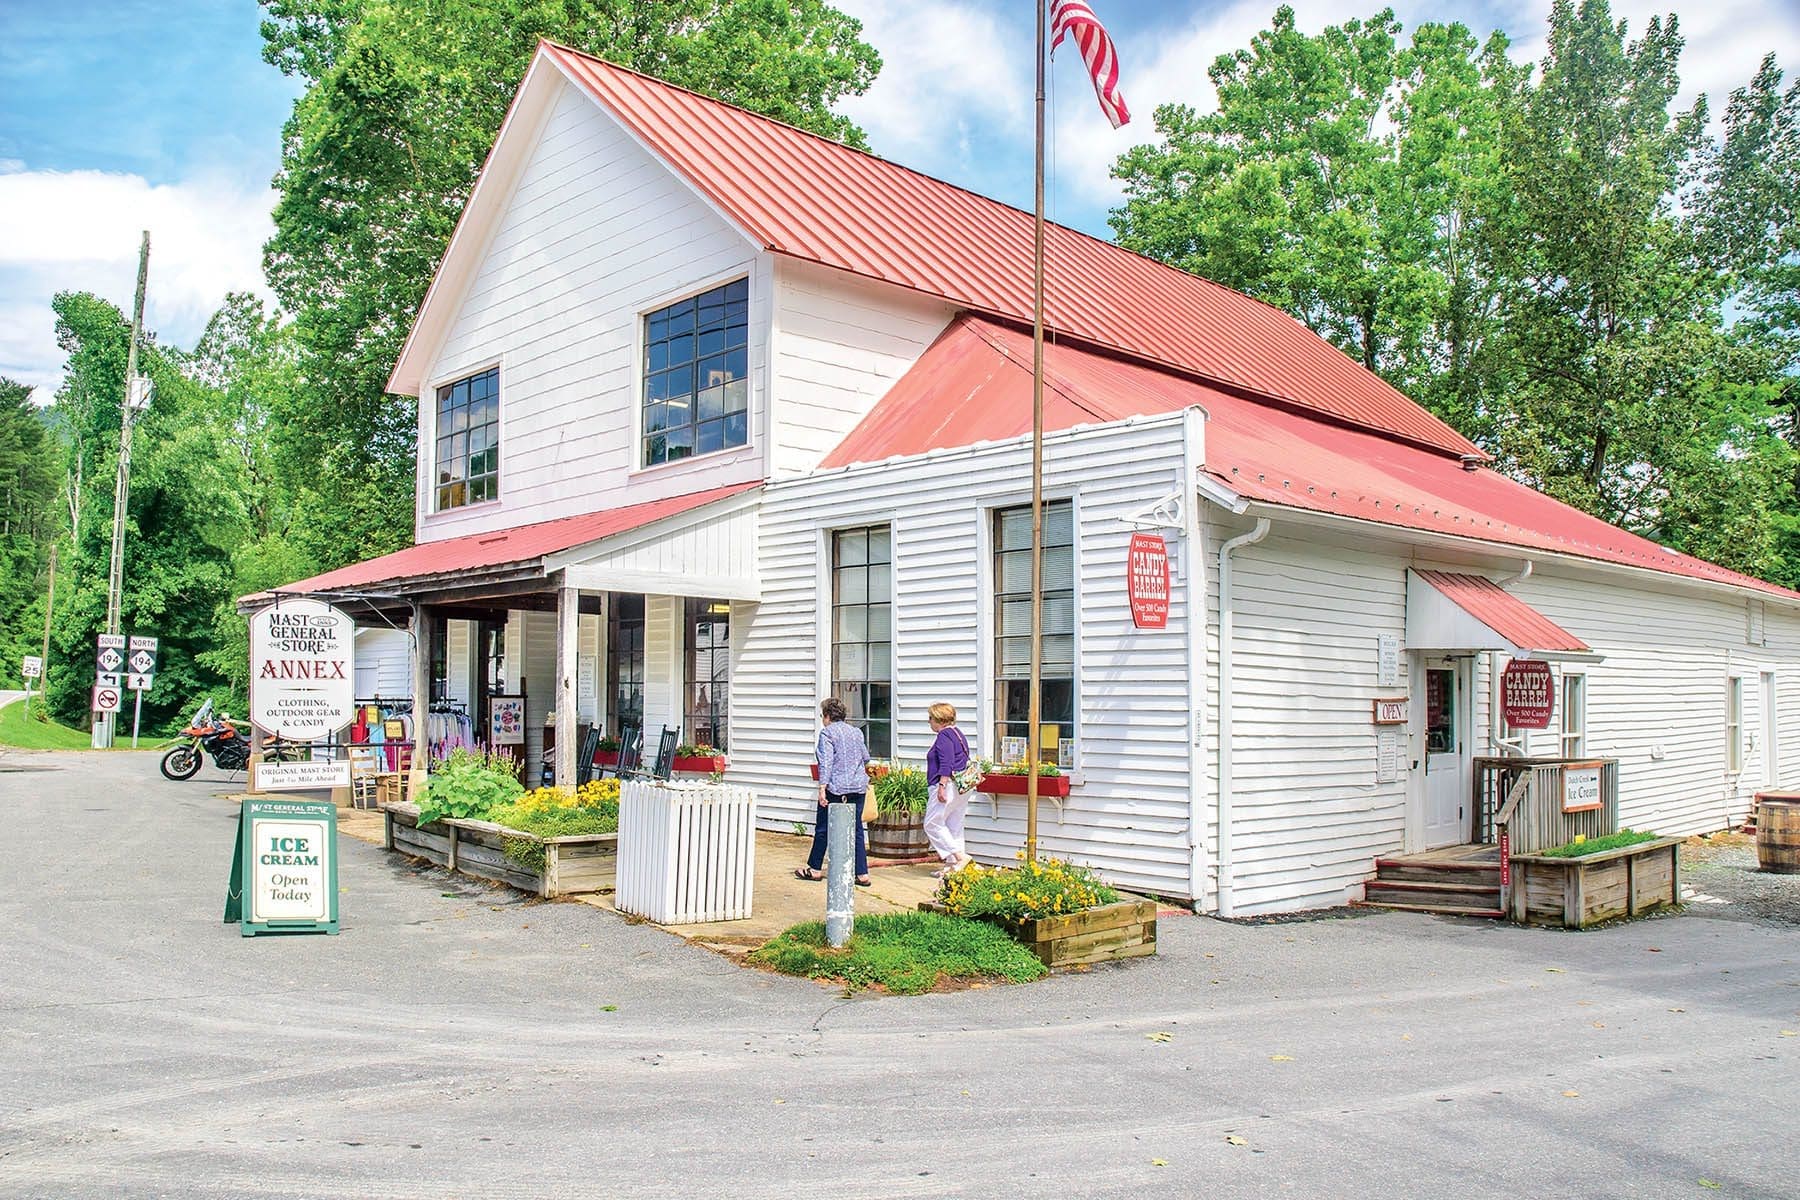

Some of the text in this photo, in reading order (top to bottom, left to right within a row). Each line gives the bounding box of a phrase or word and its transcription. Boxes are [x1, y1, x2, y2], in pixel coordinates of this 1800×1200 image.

[1133, 551, 1166, 576] CANDY
[1133, 575, 1166, 600] BARREL
[1134, 603, 1145, 612] Over
[1154, 604, 1166, 613] Candy
[269, 613, 309, 628] MAST
[271, 627, 336, 640] GENERAL
[101, 637, 122, 645] SOUTH
[132, 639, 155, 647] NORTH
[282, 640, 325, 654] STORE
[102, 655, 119, 664] 194
[134, 657, 151, 666] 194
[24, 666, 39, 675] 25
[260, 660, 346, 679] ANNEX
[1506, 672, 1549, 690] CANDY
[278, 699, 330, 707] CLOTHING,
[1506, 690, 1549, 707] BARREL
[266, 709, 341, 717] OUTDOOR GEAR
[1382, 703, 1401, 720] OPEN
[1531, 710, 1549, 718] Candy
[293, 719, 326, 727] CANDY
[1515, 716, 1540, 724] Favorites
[261, 768, 298, 776] ORIGINAL
[1568, 786, 1598, 800] Ice Cream
[270, 837, 309, 852] ICE
[260, 854, 319, 866] CREAM
[271, 873, 308, 887] Open
[269, 888, 312, 903] Today
